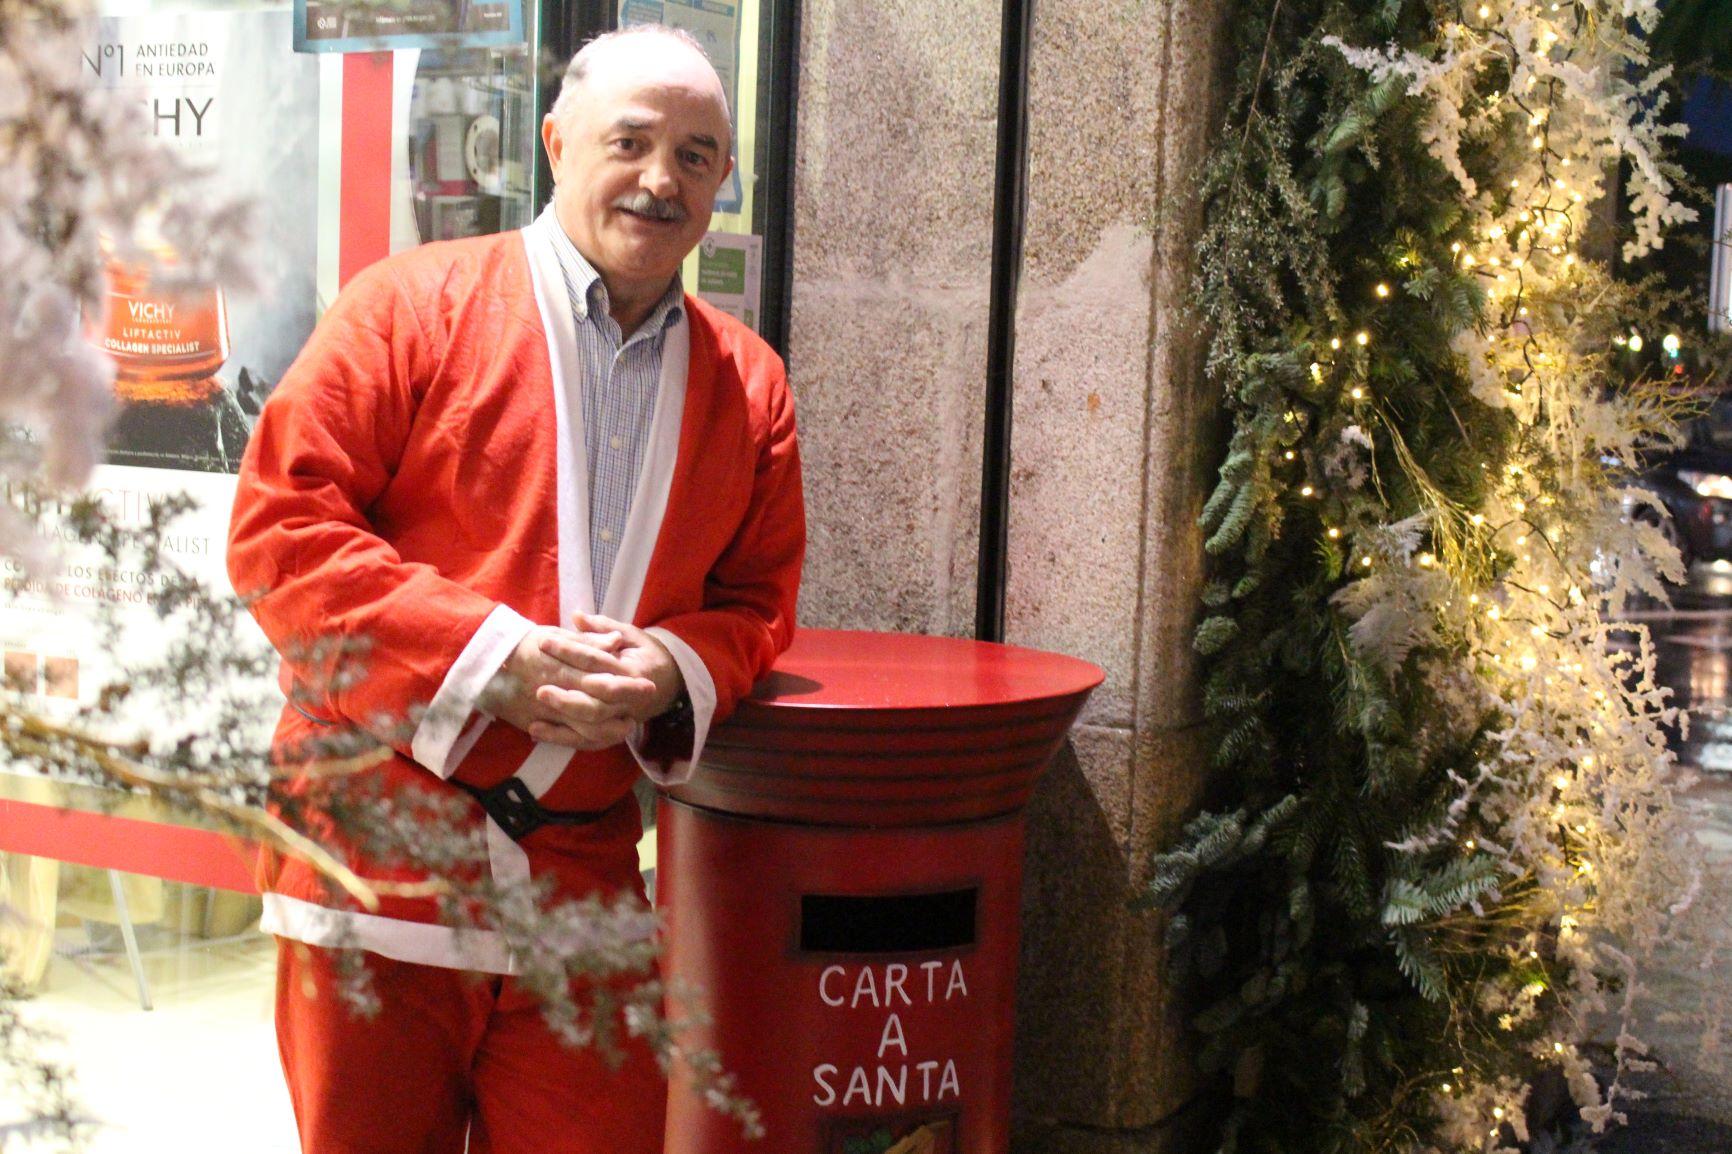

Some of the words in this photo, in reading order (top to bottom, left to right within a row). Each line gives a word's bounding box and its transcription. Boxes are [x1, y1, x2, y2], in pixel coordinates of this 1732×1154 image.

[136, 43, 209, 58] ANTIEDAD
[135, 62, 153, 77] EN
[159, 61, 216, 77] EUROPA
[128, 300, 175, 319] VICHY
[122, 327, 182, 340] LIFTACTIV
[104, 337, 149, 354] COLLAGEN
[151, 340, 200, 355] SPECIALIST
[67, 565, 92, 579] LOS
[819, 958, 968, 1008] CARTA
[877, 1012, 908, 1058] A
[813, 1058, 960, 1107] SANTA
